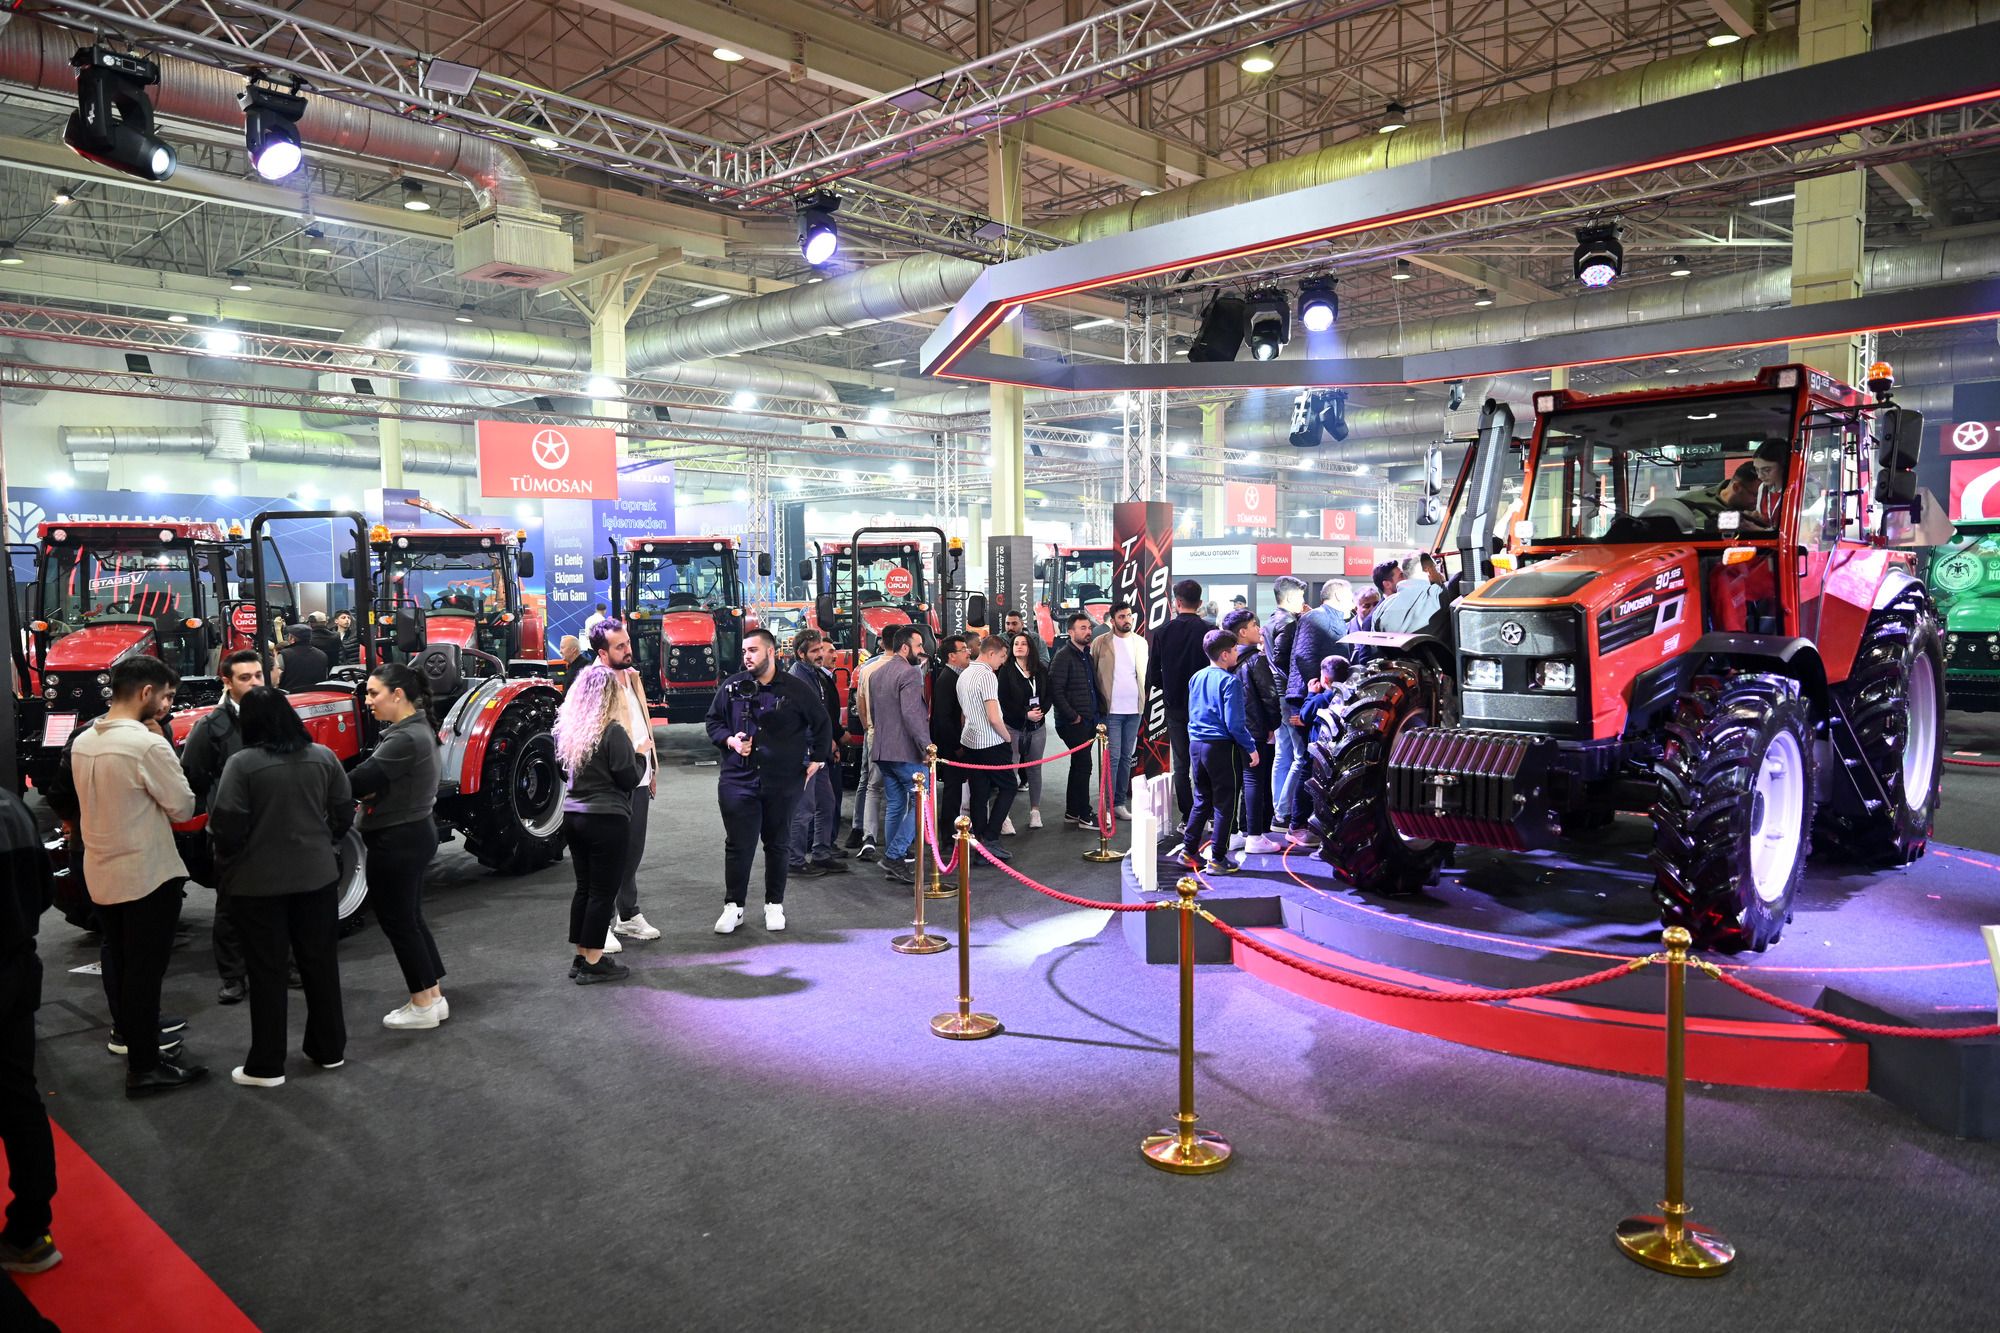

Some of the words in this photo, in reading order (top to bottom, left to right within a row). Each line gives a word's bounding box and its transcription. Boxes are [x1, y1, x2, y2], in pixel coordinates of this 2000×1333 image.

[510, 474, 593, 494] TÜMOSAN
[602, 512, 667, 531] İşlemeden
[1237, 512, 1267, 524] TÜMOSAN
[554, 555, 563, 566] En
[564, 553, 583, 568] Geniş
[1267, 556, 1289, 564] TÜMOSAN
[555, 572, 584, 586] Ekipman
[553, 587, 568, 602] Ürün
[569, 589, 588, 601] Gamı
[1619, 594, 1654, 616] TÜMOSAN
[1148, 726, 1168, 743] RETRO
